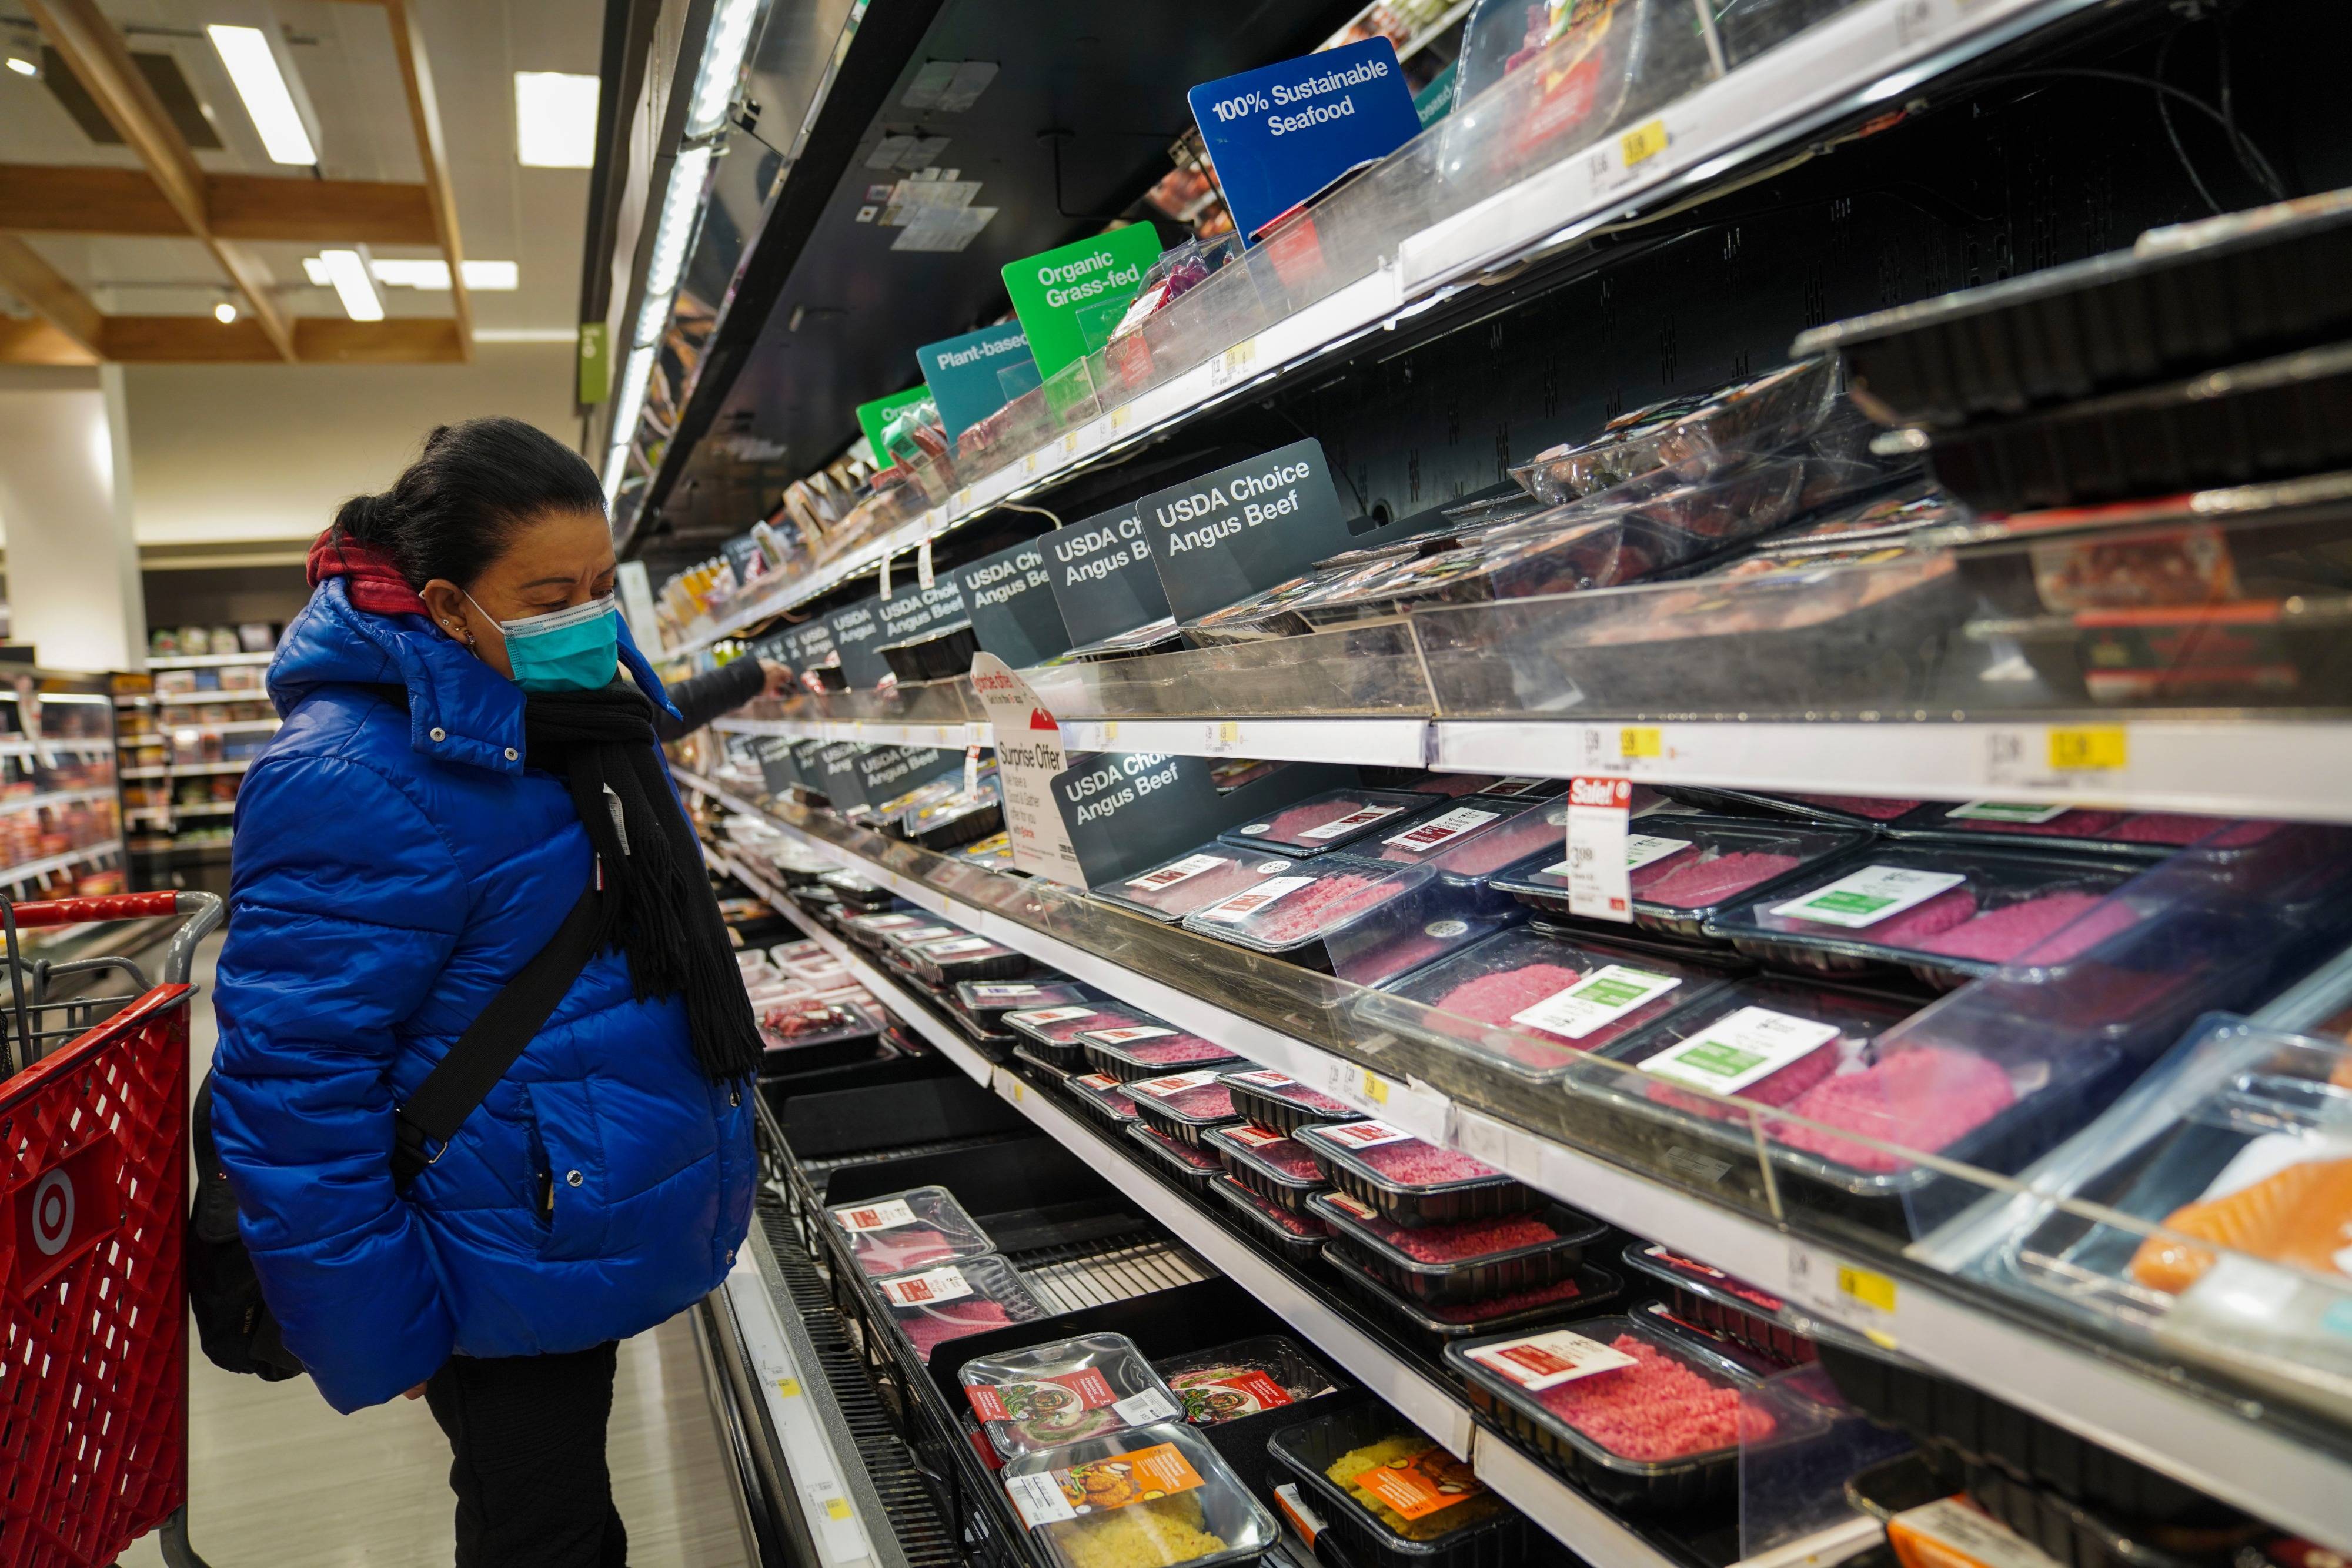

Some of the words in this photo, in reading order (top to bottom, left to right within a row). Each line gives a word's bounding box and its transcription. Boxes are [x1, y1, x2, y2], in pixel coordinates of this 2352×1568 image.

[1212, 91, 1269, 123] 100%
[1271, 59, 1388, 106] Sustainable
[1268, 95, 1355, 136] Seafood
[1038, 250, 1114, 286] Organic
[1045, 263, 1141, 308] Grass-fed
[1155, 488, 1229, 529] USDA
[1230, 462, 1310, 501] Choice
[1168, 517, 1242, 556] Angus
[1244, 489, 1299, 527] Beef
[1055, 527, 1118, 562] USDA
[965, 560, 1017, 590] USDA
[1066, 551, 1130, 586] Angus
[879, 595, 923, 621] USDA
[975, 579, 1027, 609] Angus
[833, 608, 871, 631] USDA
[887, 611, 931, 637] Angus
[930, 595, 965, 619] Beef
[860, 749, 901, 774] USDA
[867, 763, 908, 788] Angus
[907, 748, 939, 770] Beef
[1000, 742, 1034, 771] Surprise
[1035, 743, 1060, 770] Offer
[1065, 765, 1124, 802] USDA
[1077, 787, 1135, 825] Angus
[1134, 762, 1178, 796] Beef
[1570, 777, 1615, 806] Sale!
